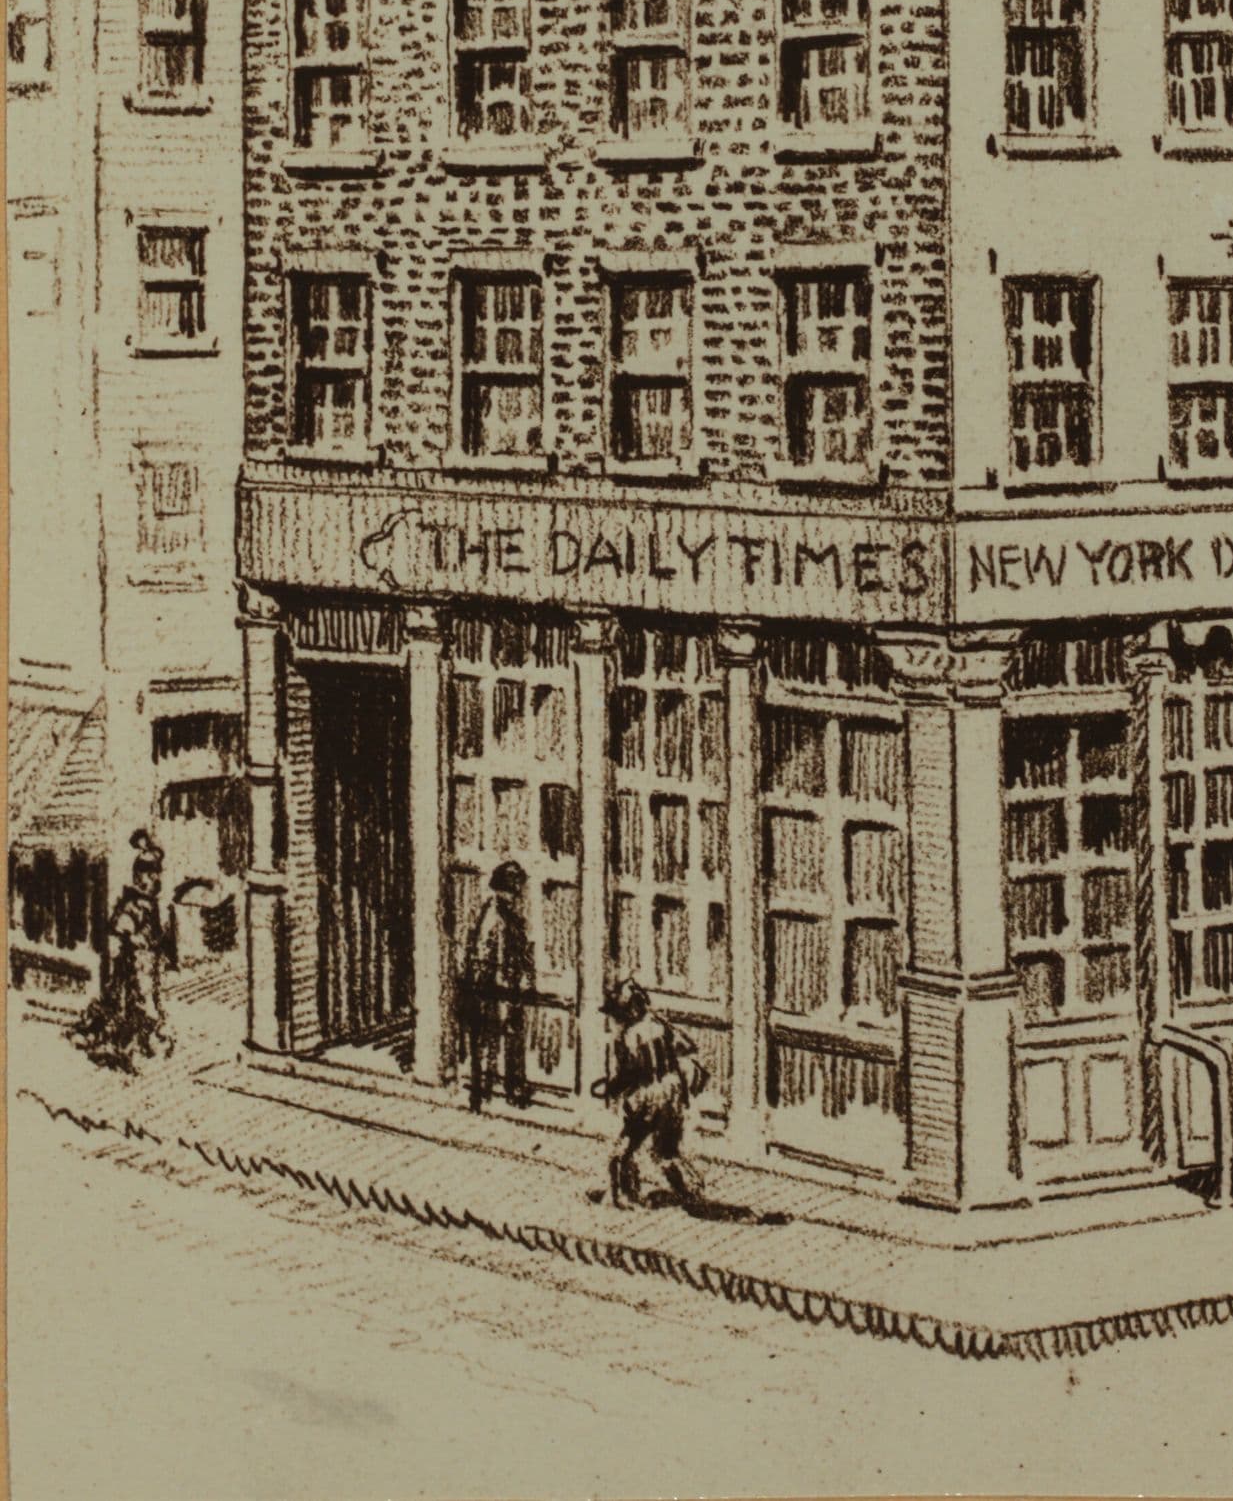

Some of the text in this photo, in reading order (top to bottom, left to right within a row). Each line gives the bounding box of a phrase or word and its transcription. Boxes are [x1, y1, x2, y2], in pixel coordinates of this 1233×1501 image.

[419, 522, 931, 598] THE DAILY TIMES
[969, 543, 1068, 592] NEW
[1075, 536, 1194, 586] YORK
